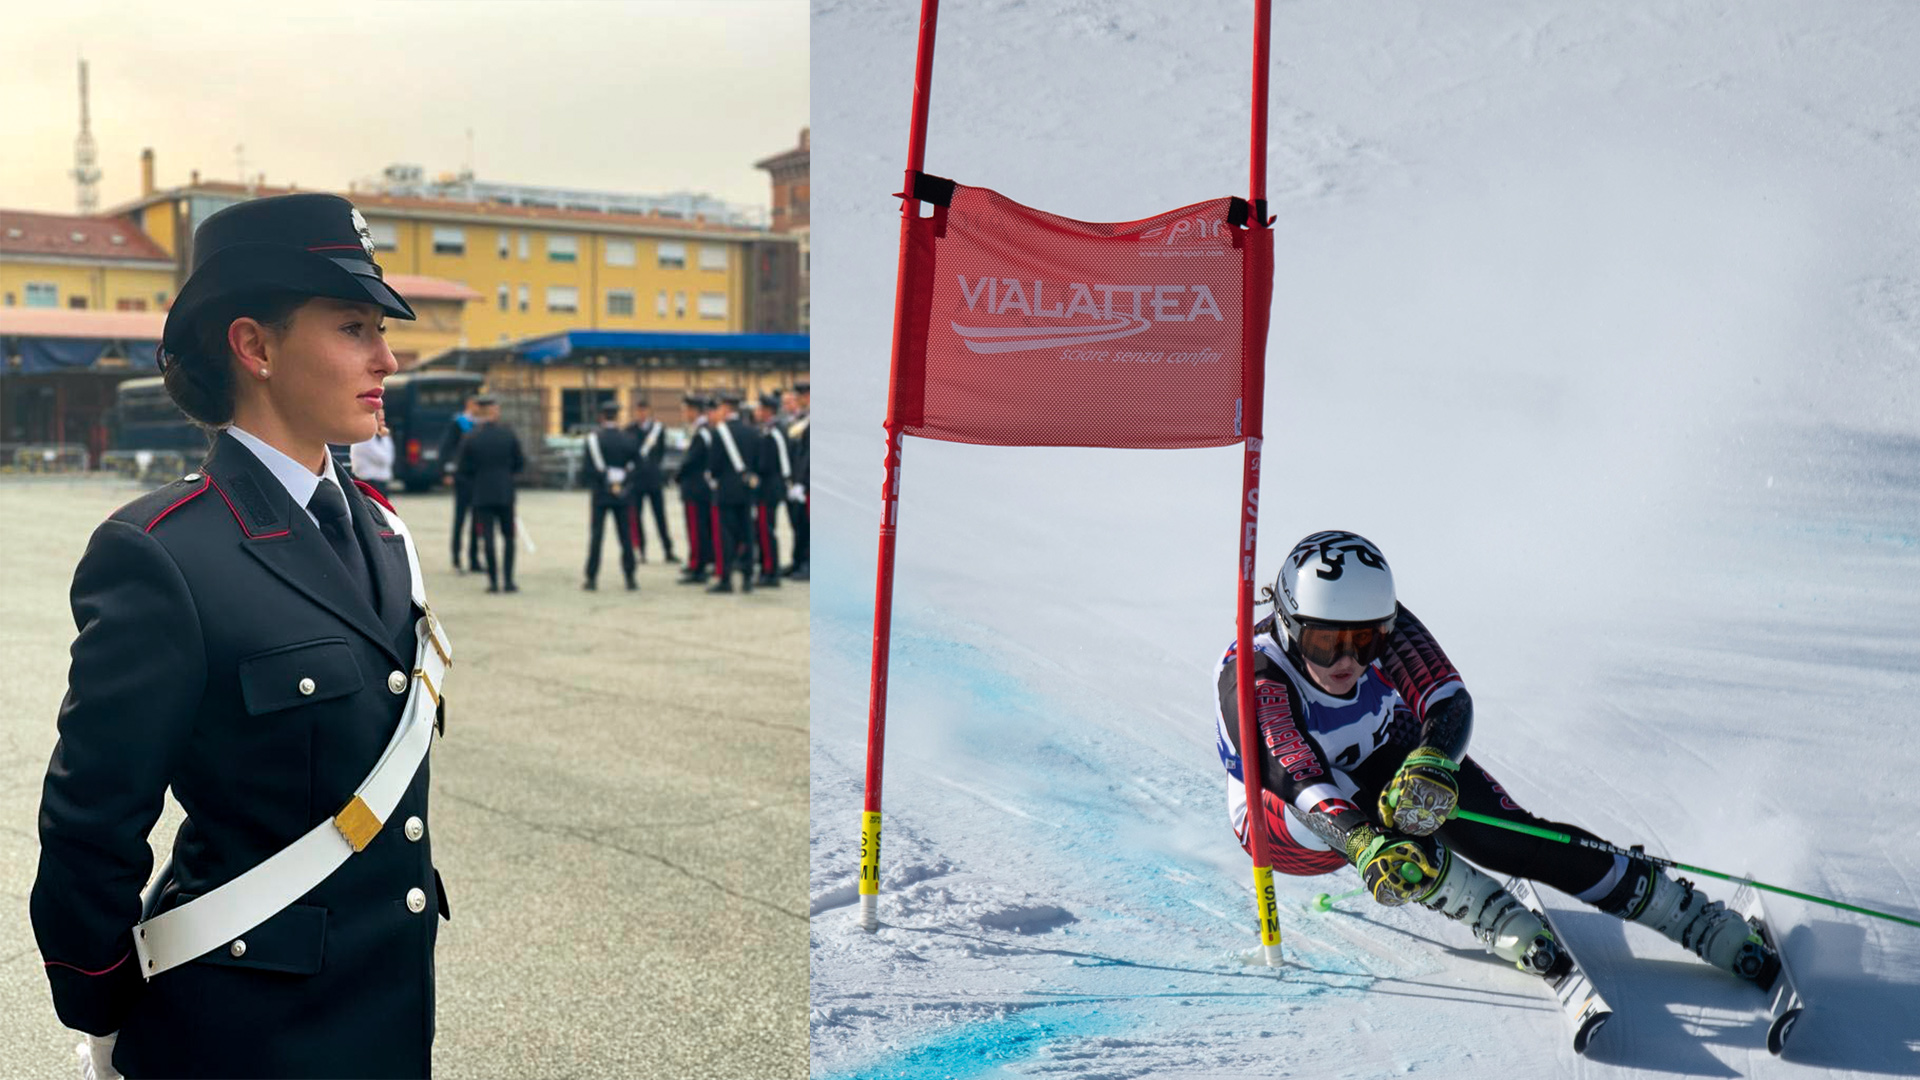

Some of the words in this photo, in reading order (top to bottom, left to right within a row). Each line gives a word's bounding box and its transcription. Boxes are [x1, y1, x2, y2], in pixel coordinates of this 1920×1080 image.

[957, 274, 1224, 322] VIALATTEA
[1112, 350, 1164, 363] senza
[1166, 346, 1224, 367] confini
[1255, 679, 1324, 781] CARABINIERI
[1422, 766, 1451, 782] LEVEL
